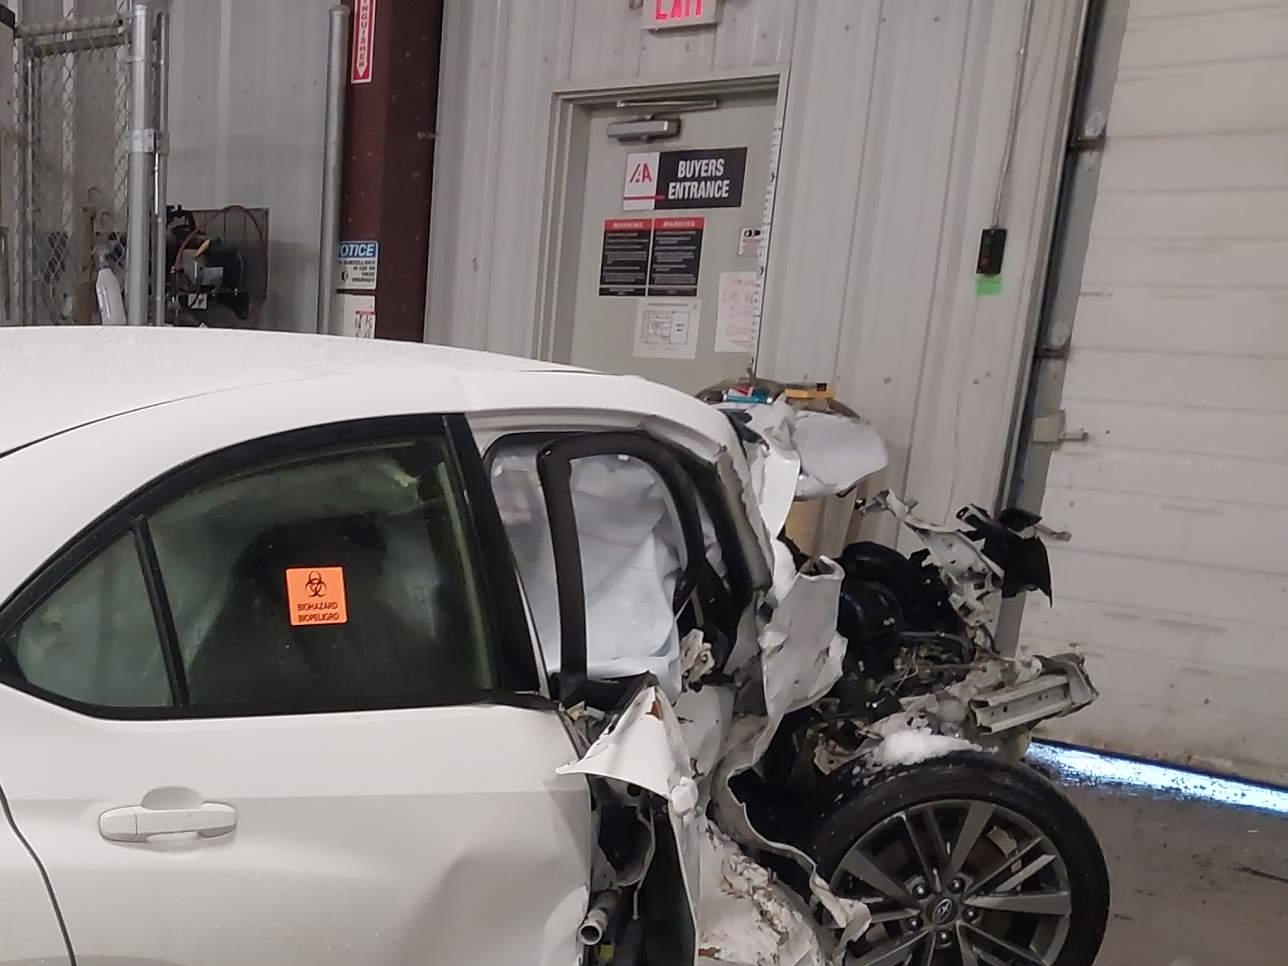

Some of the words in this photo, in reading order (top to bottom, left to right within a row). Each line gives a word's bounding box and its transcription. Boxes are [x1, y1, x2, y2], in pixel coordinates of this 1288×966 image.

[677, 158, 725, 179] BUYERS
[668, 180, 730, 200] ENTRANCE
[339, 243, 375, 257] OTICE
[297, 601, 339, 611] BIOHAZARD
[297, 612, 340, 623] BIOPELIGRO
